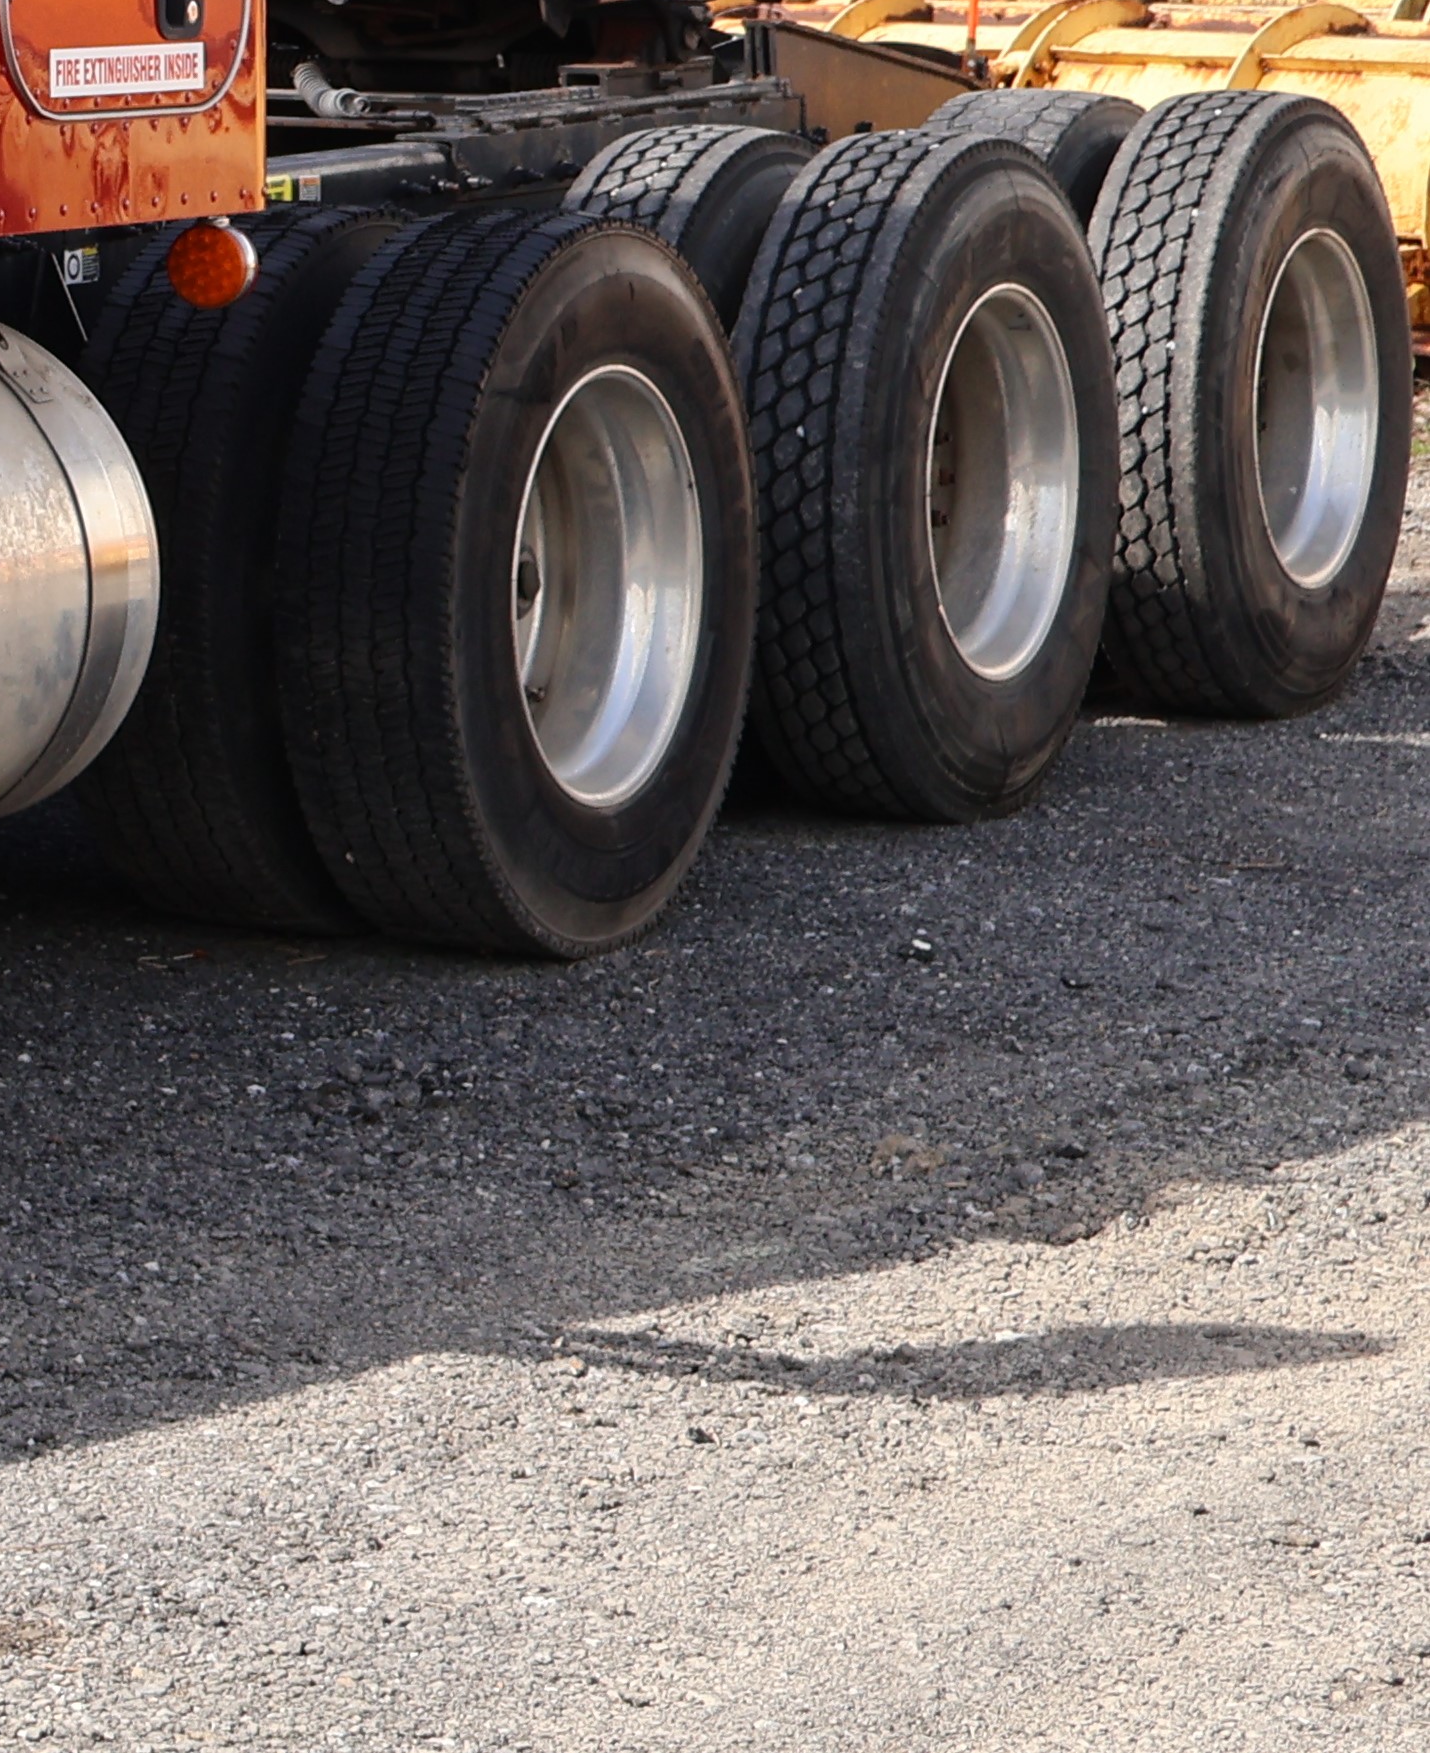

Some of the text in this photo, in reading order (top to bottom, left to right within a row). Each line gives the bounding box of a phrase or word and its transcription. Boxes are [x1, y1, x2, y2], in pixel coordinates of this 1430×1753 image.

[55, 52, 199, 87] FIRE EXTINGUISHER INSIDE
